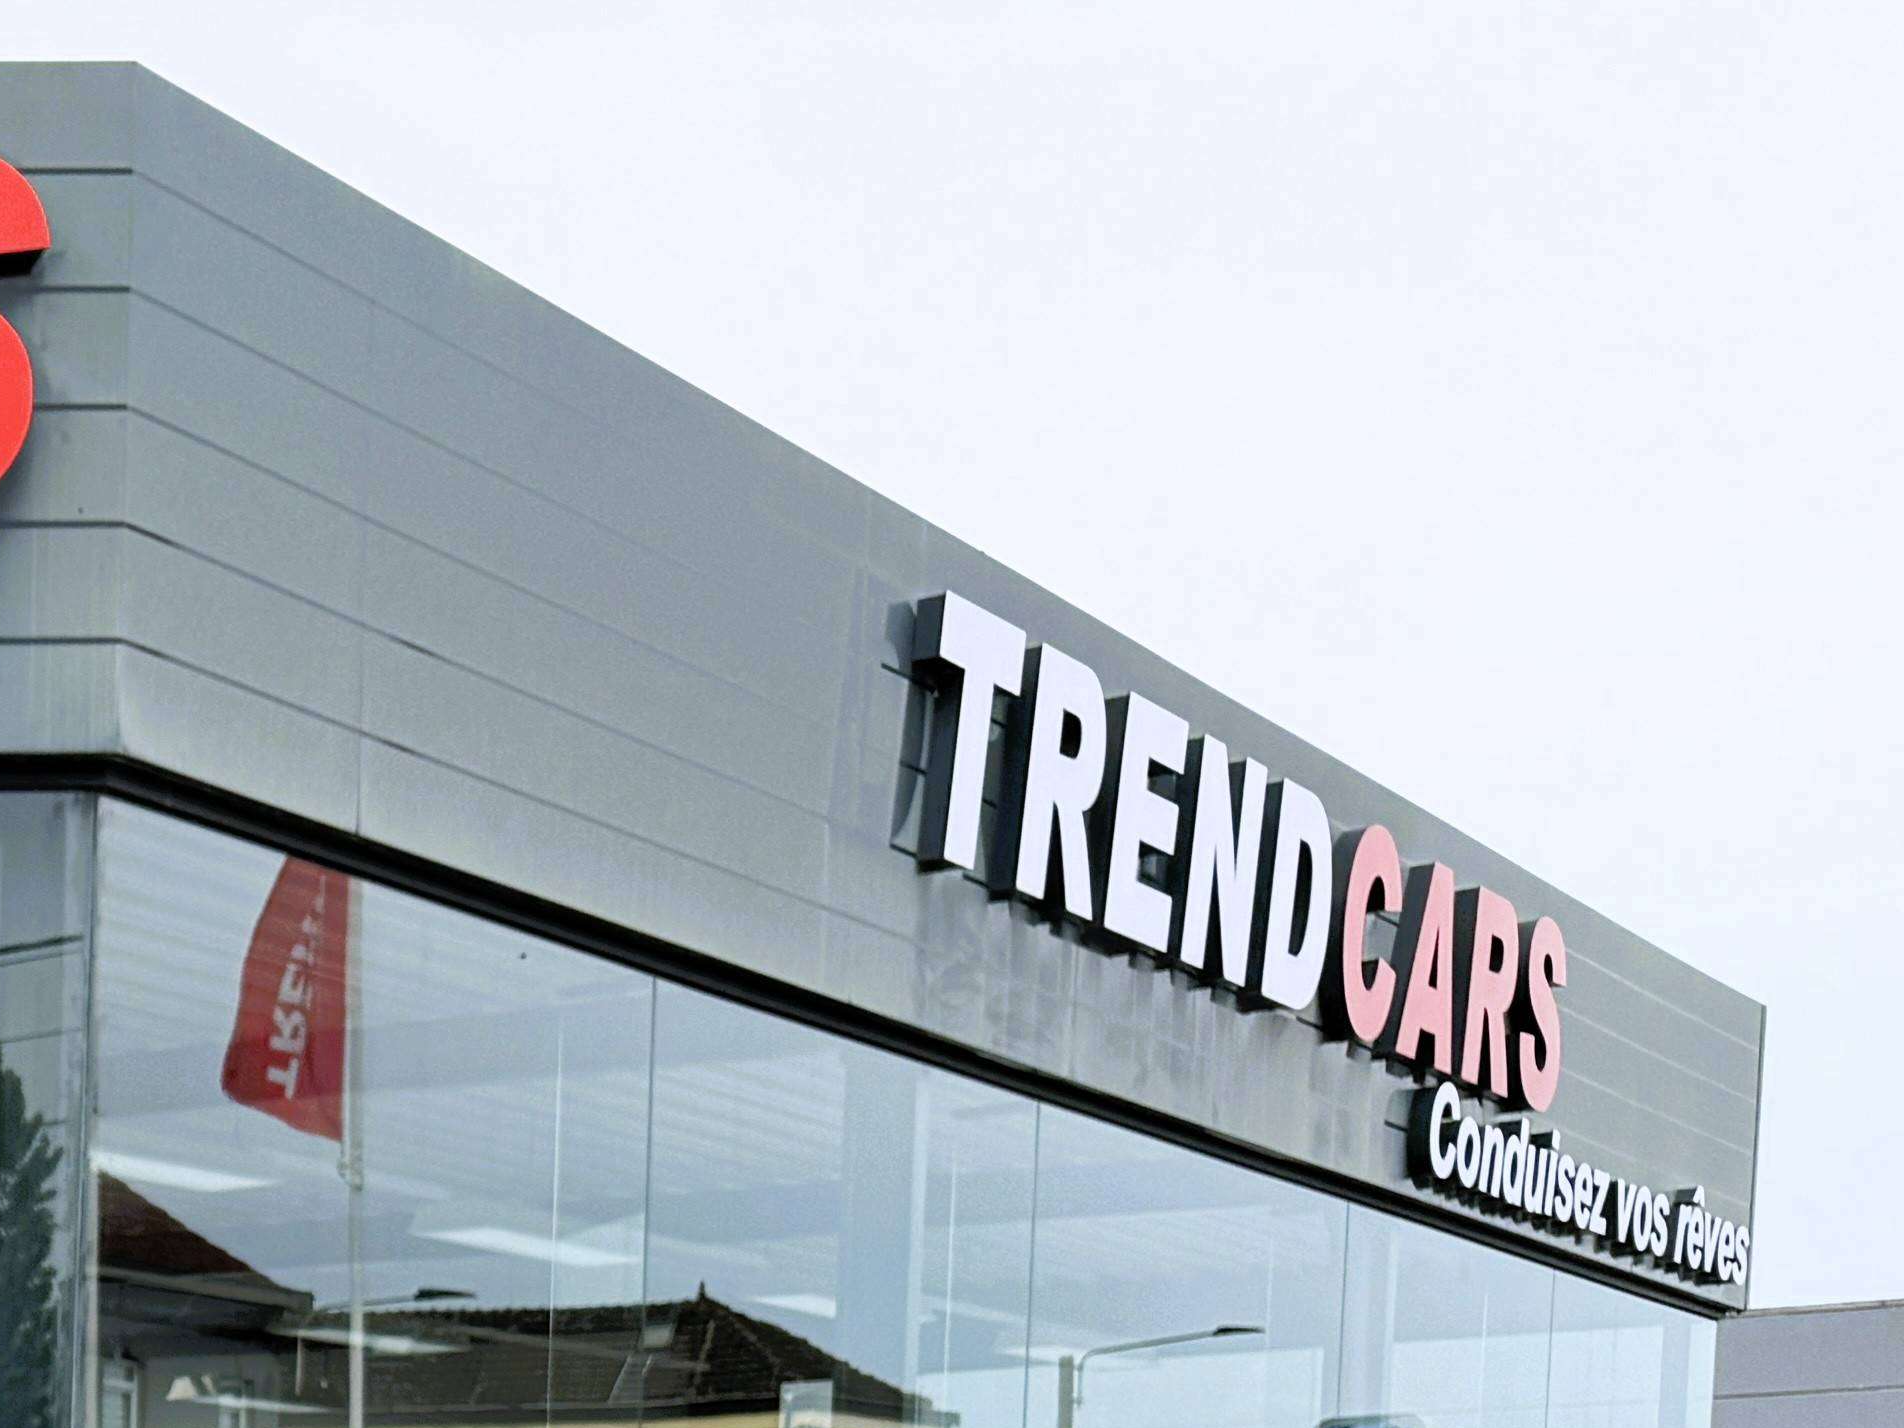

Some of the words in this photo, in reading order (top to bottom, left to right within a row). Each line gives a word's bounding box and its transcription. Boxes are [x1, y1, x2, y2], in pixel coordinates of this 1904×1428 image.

[937, 590, 1333, 1012] TREND
[1341, 824, 1568, 1113] CARS
[1429, 1081, 1610, 1236] Conduisez
[1617, 1178, 1670, 1257] vos
[1673, 1184, 1750, 1286] rêves
